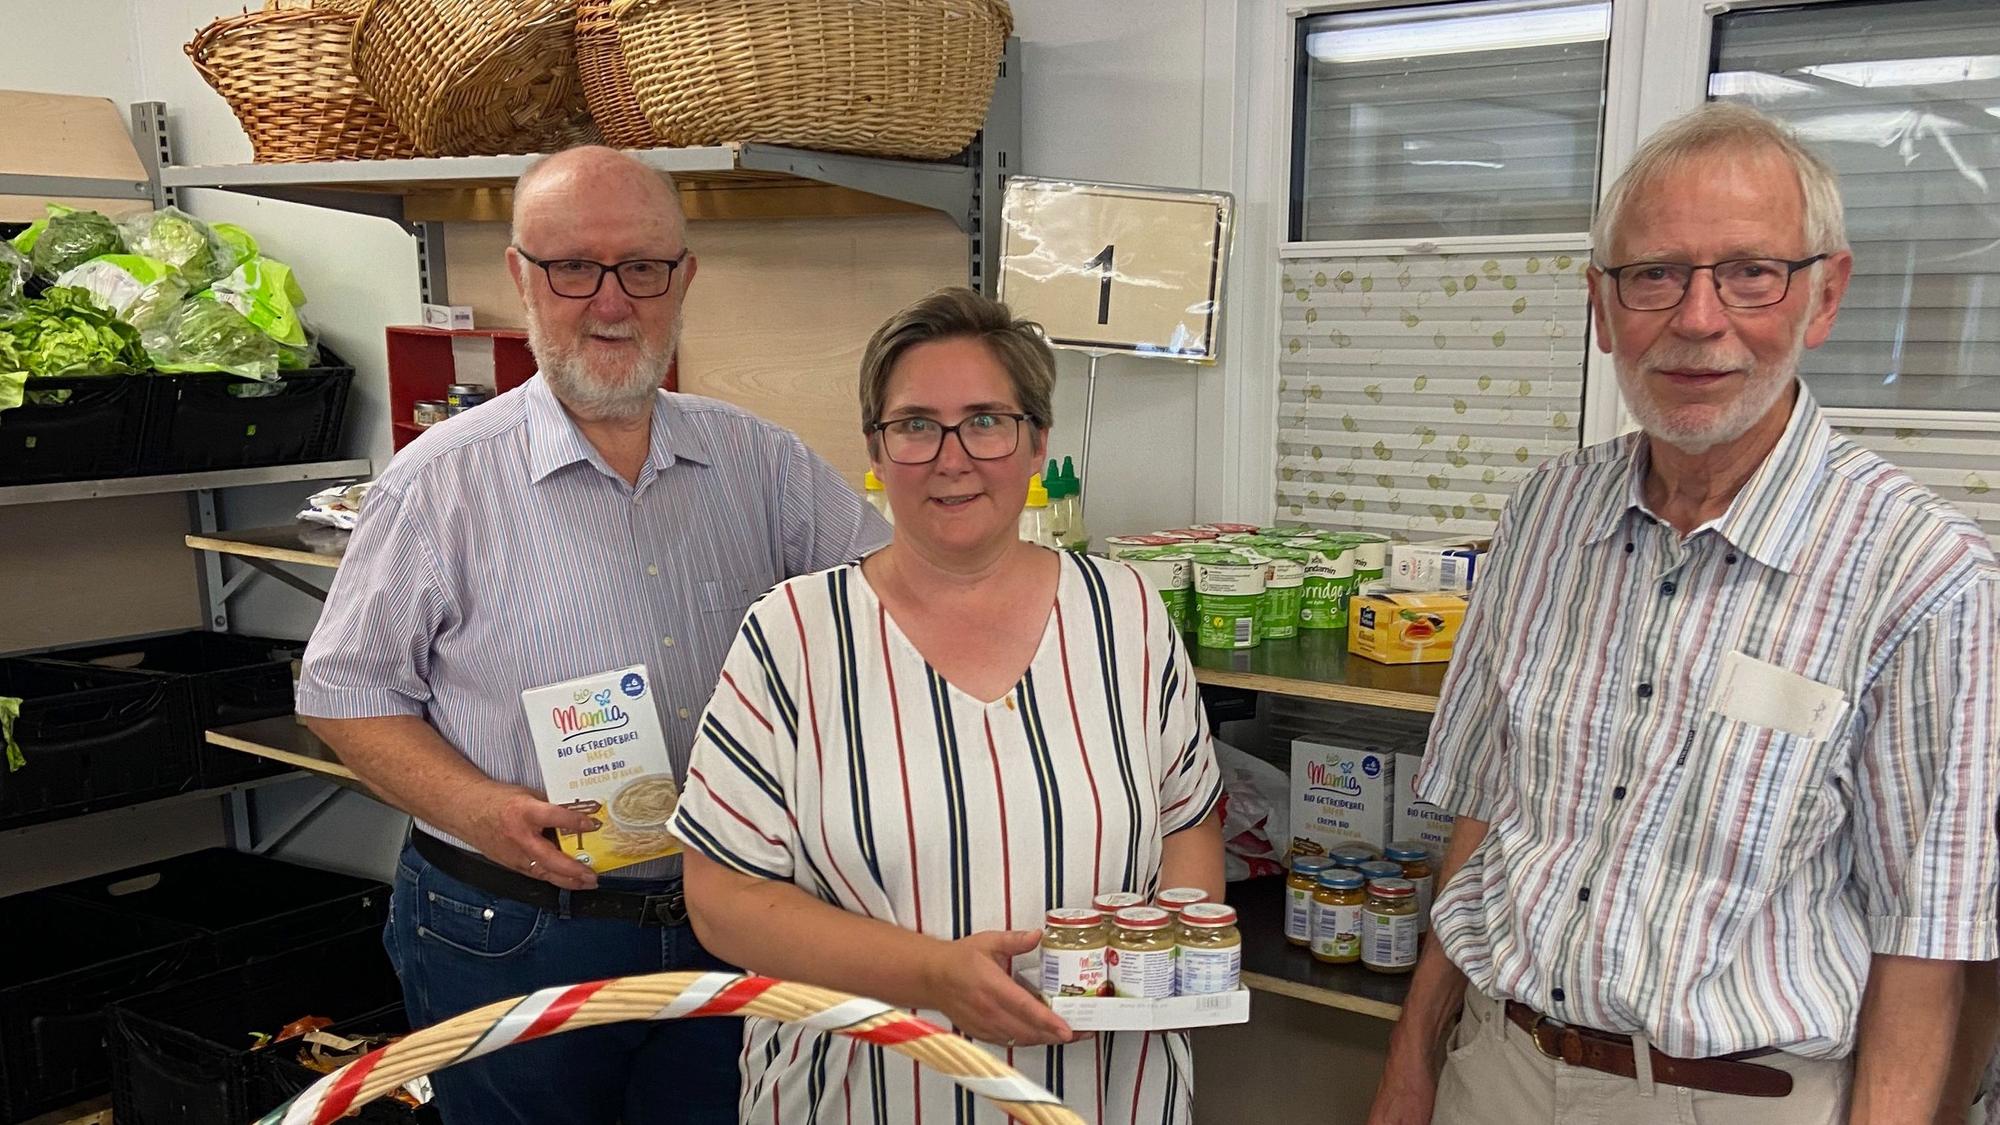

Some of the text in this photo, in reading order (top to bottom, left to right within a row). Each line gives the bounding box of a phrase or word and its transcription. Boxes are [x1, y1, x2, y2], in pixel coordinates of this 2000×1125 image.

[1083, 244, 1115, 325] 1
[552, 705, 630, 735] Mamia
[557, 731, 639, 758] BIO GETREIDEBREI
[583, 760, 625, 777] CREMA BIO
[1307, 760, 1361, 791] Mamia
[1303, 793, 1365, 811] BIO GETREIDEBREI
[1407, 807, 1419, 817] BIO
[1317, 817, 1350, 829] CREMA BIO
